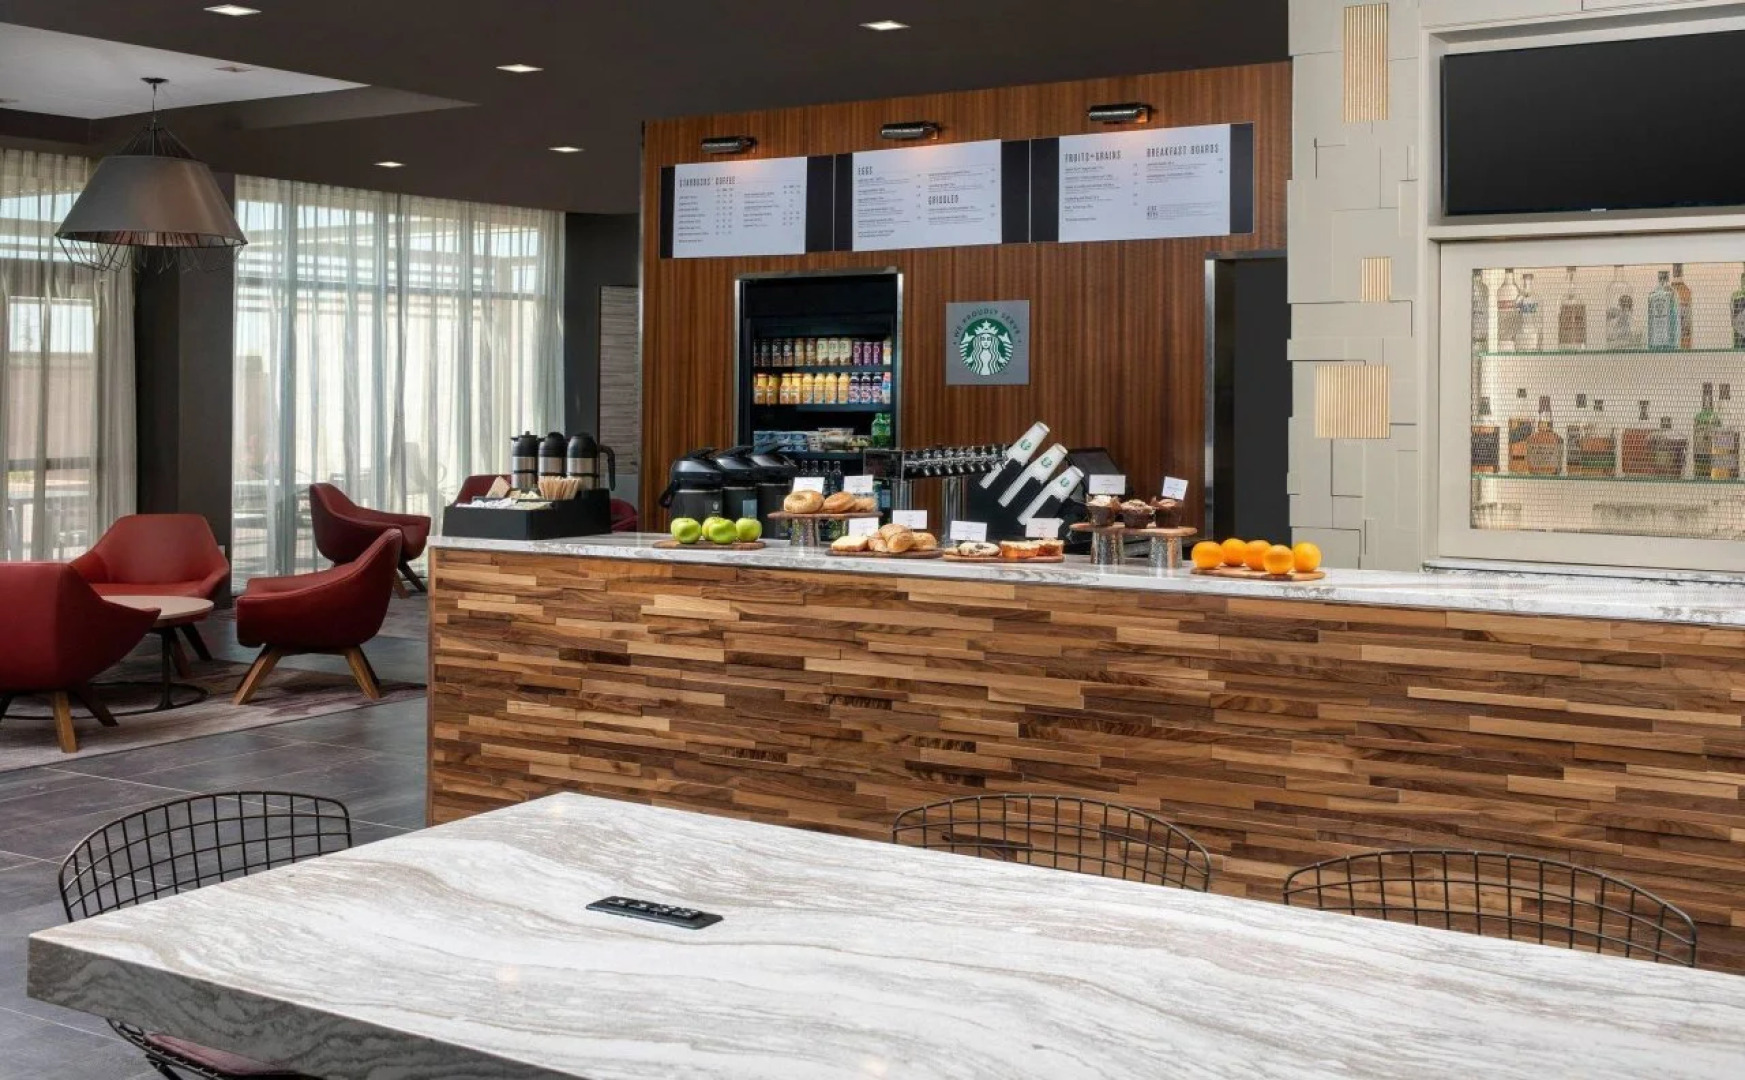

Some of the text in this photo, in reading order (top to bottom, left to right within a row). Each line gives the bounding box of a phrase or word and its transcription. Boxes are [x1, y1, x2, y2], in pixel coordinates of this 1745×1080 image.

[1146, 143, 1219, 157] BREAKFAST BOARDS
[715, 175, 736, 185] COFFEE
[954, 307, 1021, 338] WE PROUDLY SERVE
